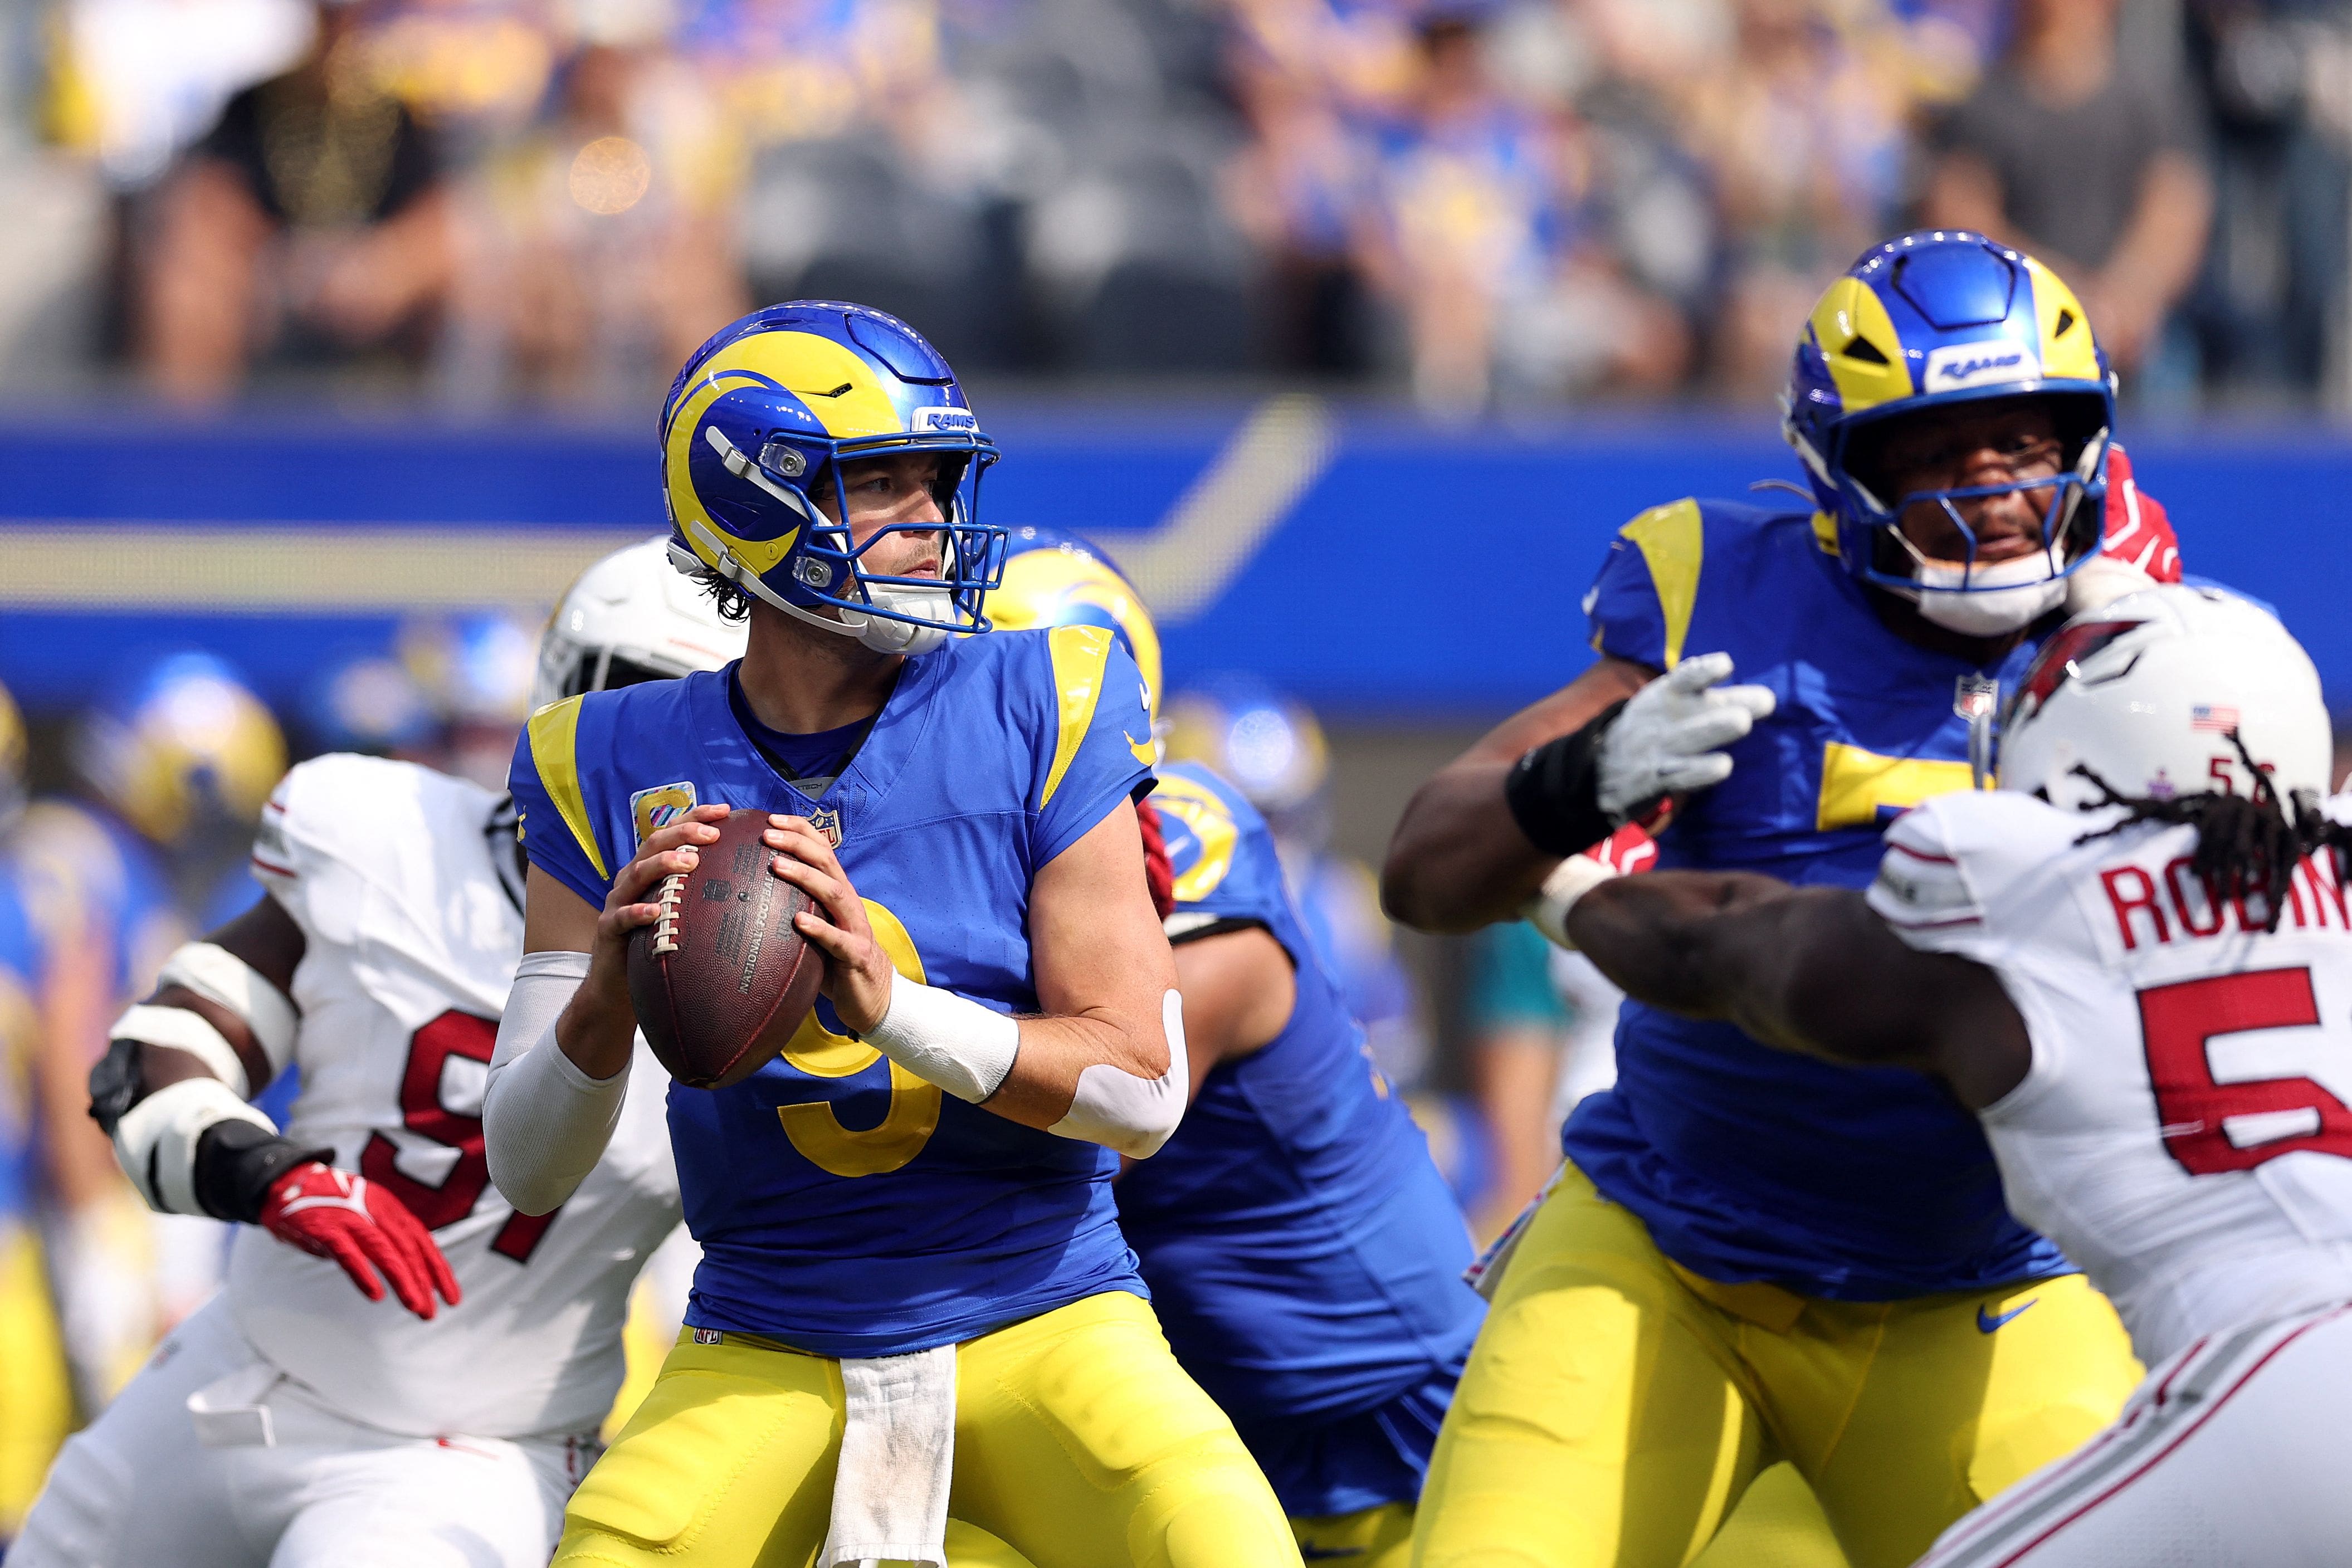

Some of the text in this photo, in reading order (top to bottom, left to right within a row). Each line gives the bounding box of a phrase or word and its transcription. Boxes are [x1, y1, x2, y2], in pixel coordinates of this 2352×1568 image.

[928, 413, 975, 431] RAMS
[738, 930, 764, 994] NATIONAL
[697, 1328, 716, 1343] NFL
